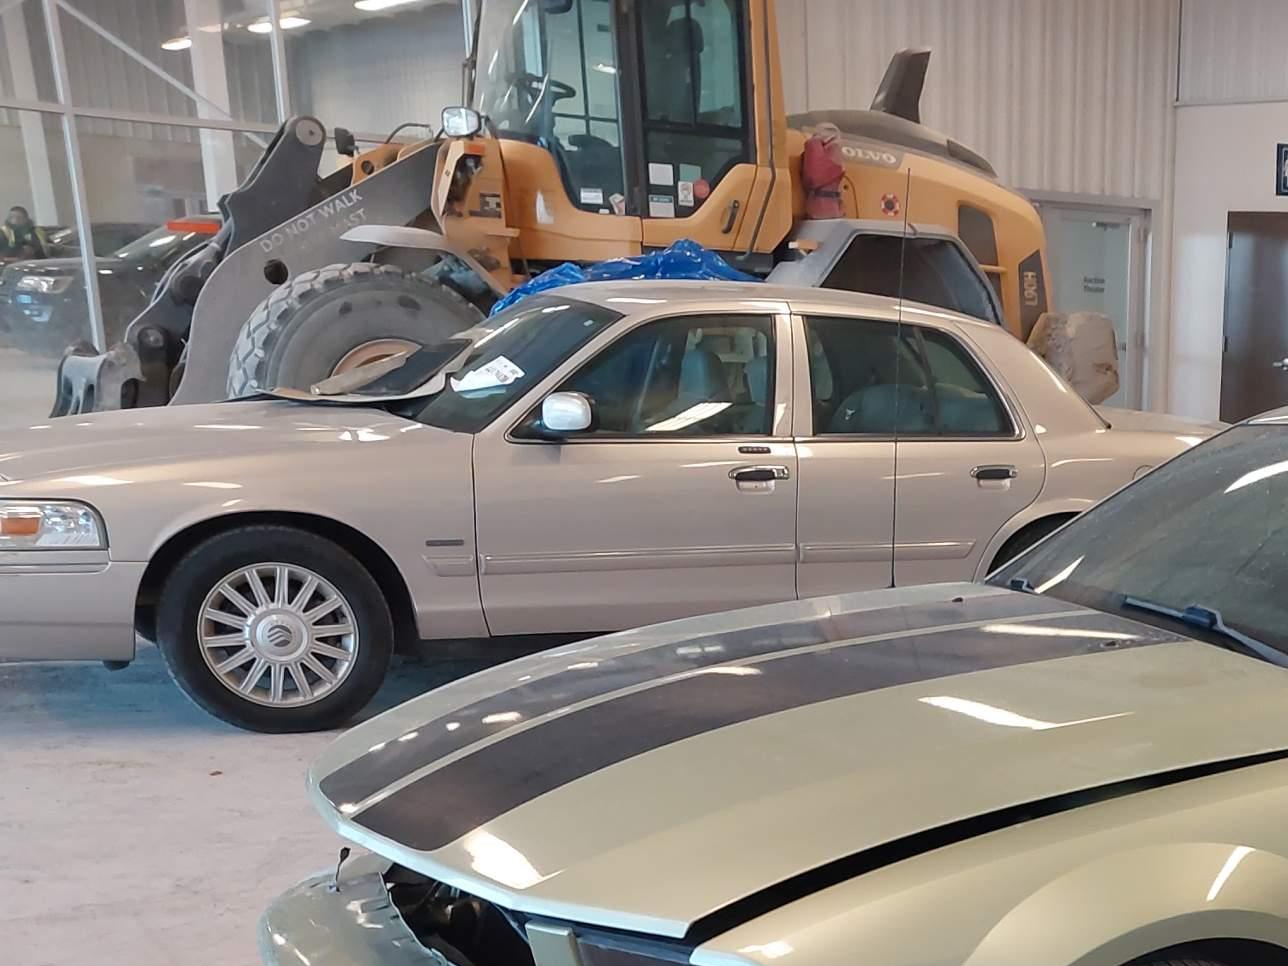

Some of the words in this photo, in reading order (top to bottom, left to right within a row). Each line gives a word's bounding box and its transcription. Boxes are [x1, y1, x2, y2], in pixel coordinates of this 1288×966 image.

[841, 146, 897, 164] OLVO
[260, 232, 284, 253] DO
[285, 213, 317, 237] NOT
[318, 188, 363, 218] WALK
